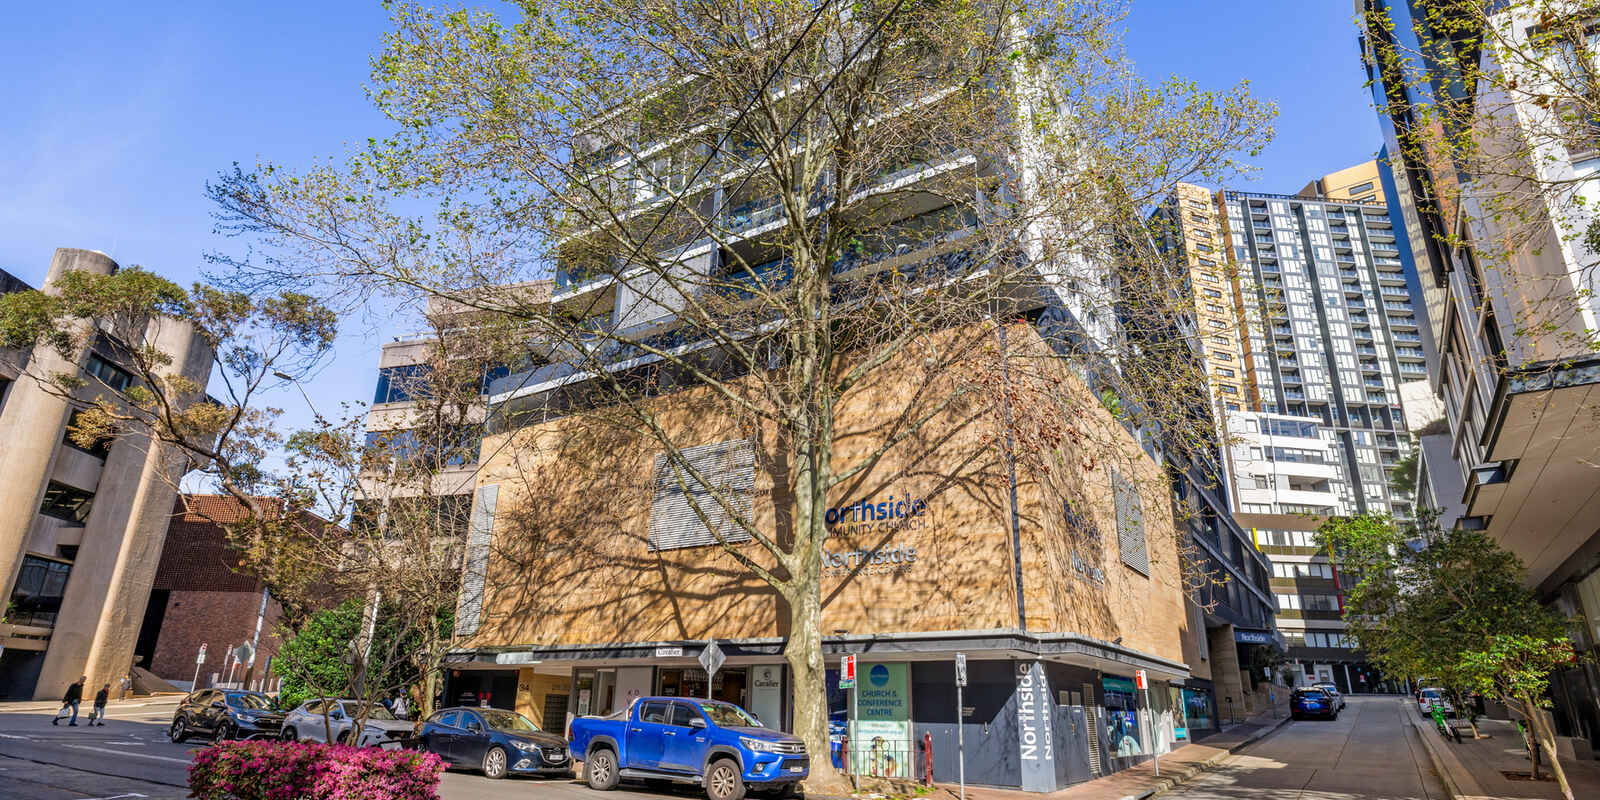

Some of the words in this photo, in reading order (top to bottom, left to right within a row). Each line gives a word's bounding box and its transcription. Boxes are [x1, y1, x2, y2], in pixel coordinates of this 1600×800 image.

[825, 492, 926, 524] orthside
[830, 522, 875, 537] MUNITY
[1016, 663, 1038, 761] Northside
